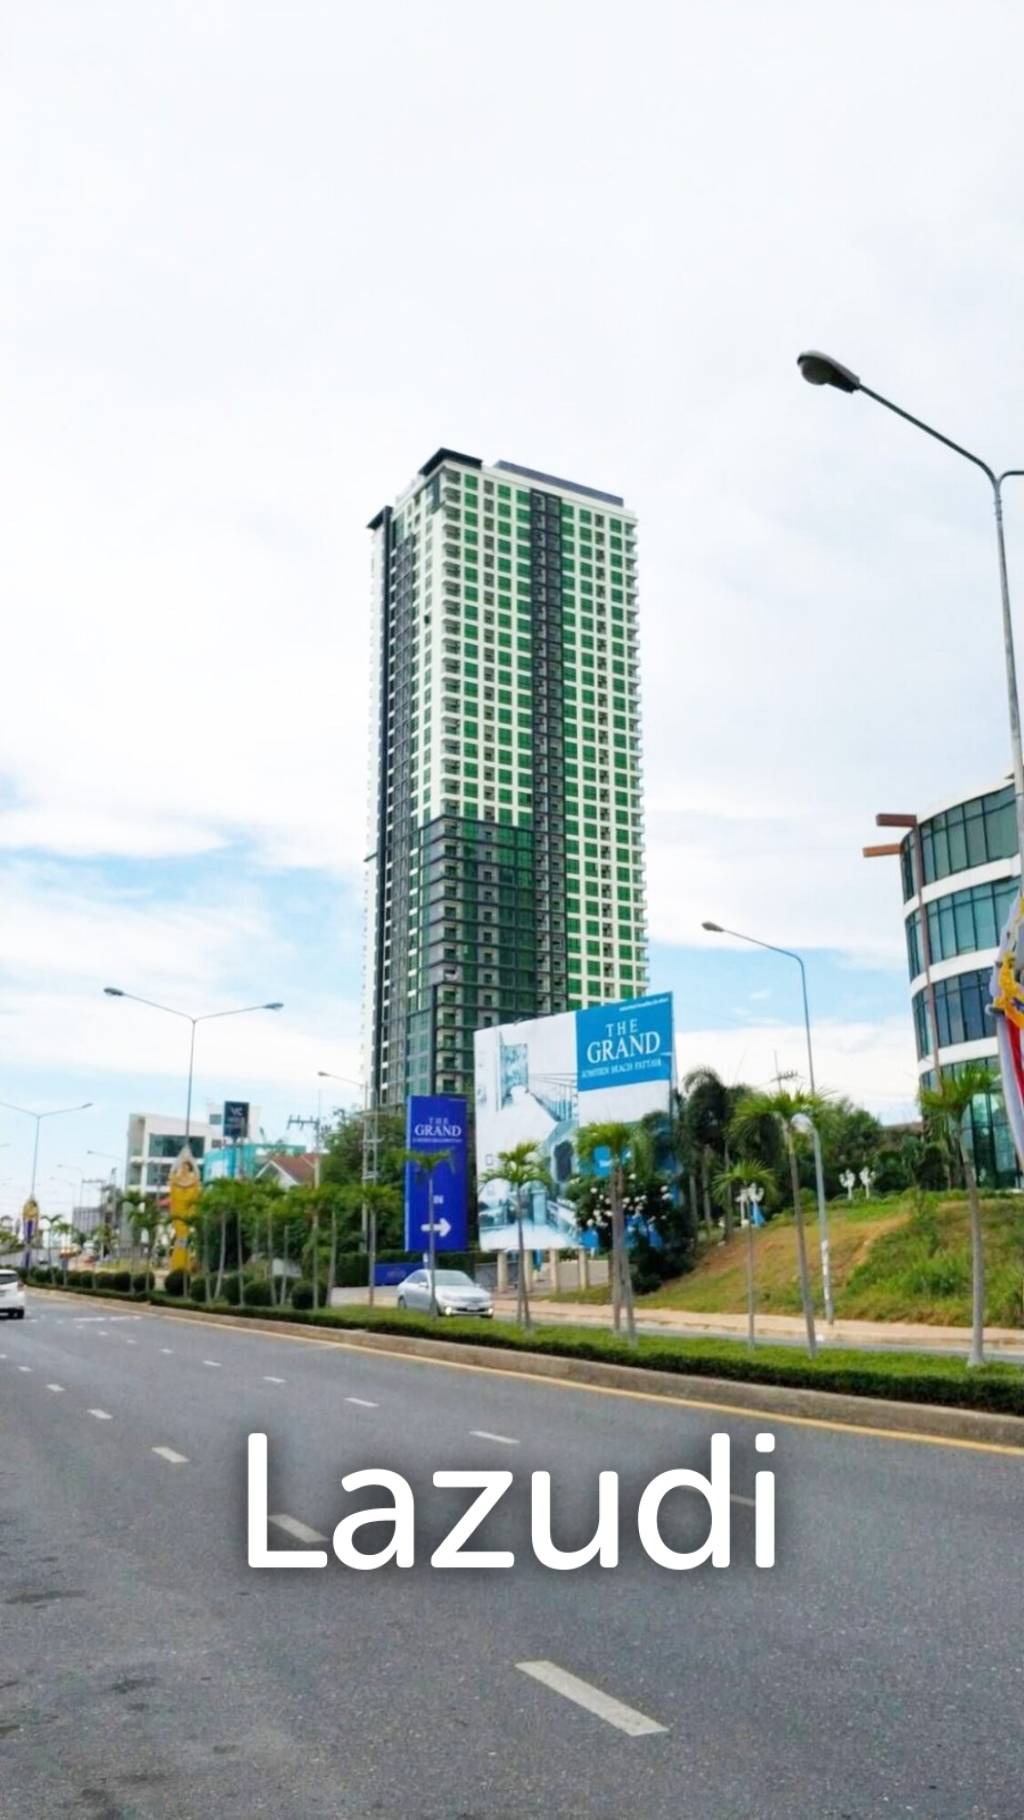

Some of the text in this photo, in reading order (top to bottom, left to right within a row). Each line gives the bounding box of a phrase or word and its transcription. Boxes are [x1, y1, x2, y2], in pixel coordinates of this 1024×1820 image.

[605, 1018, 639, 1038] THE
[586, 1030, 661, 1064] GRAND
[429, 1116, 449, 1125] THE
[414, 1124, 462, 1137] GRAND
